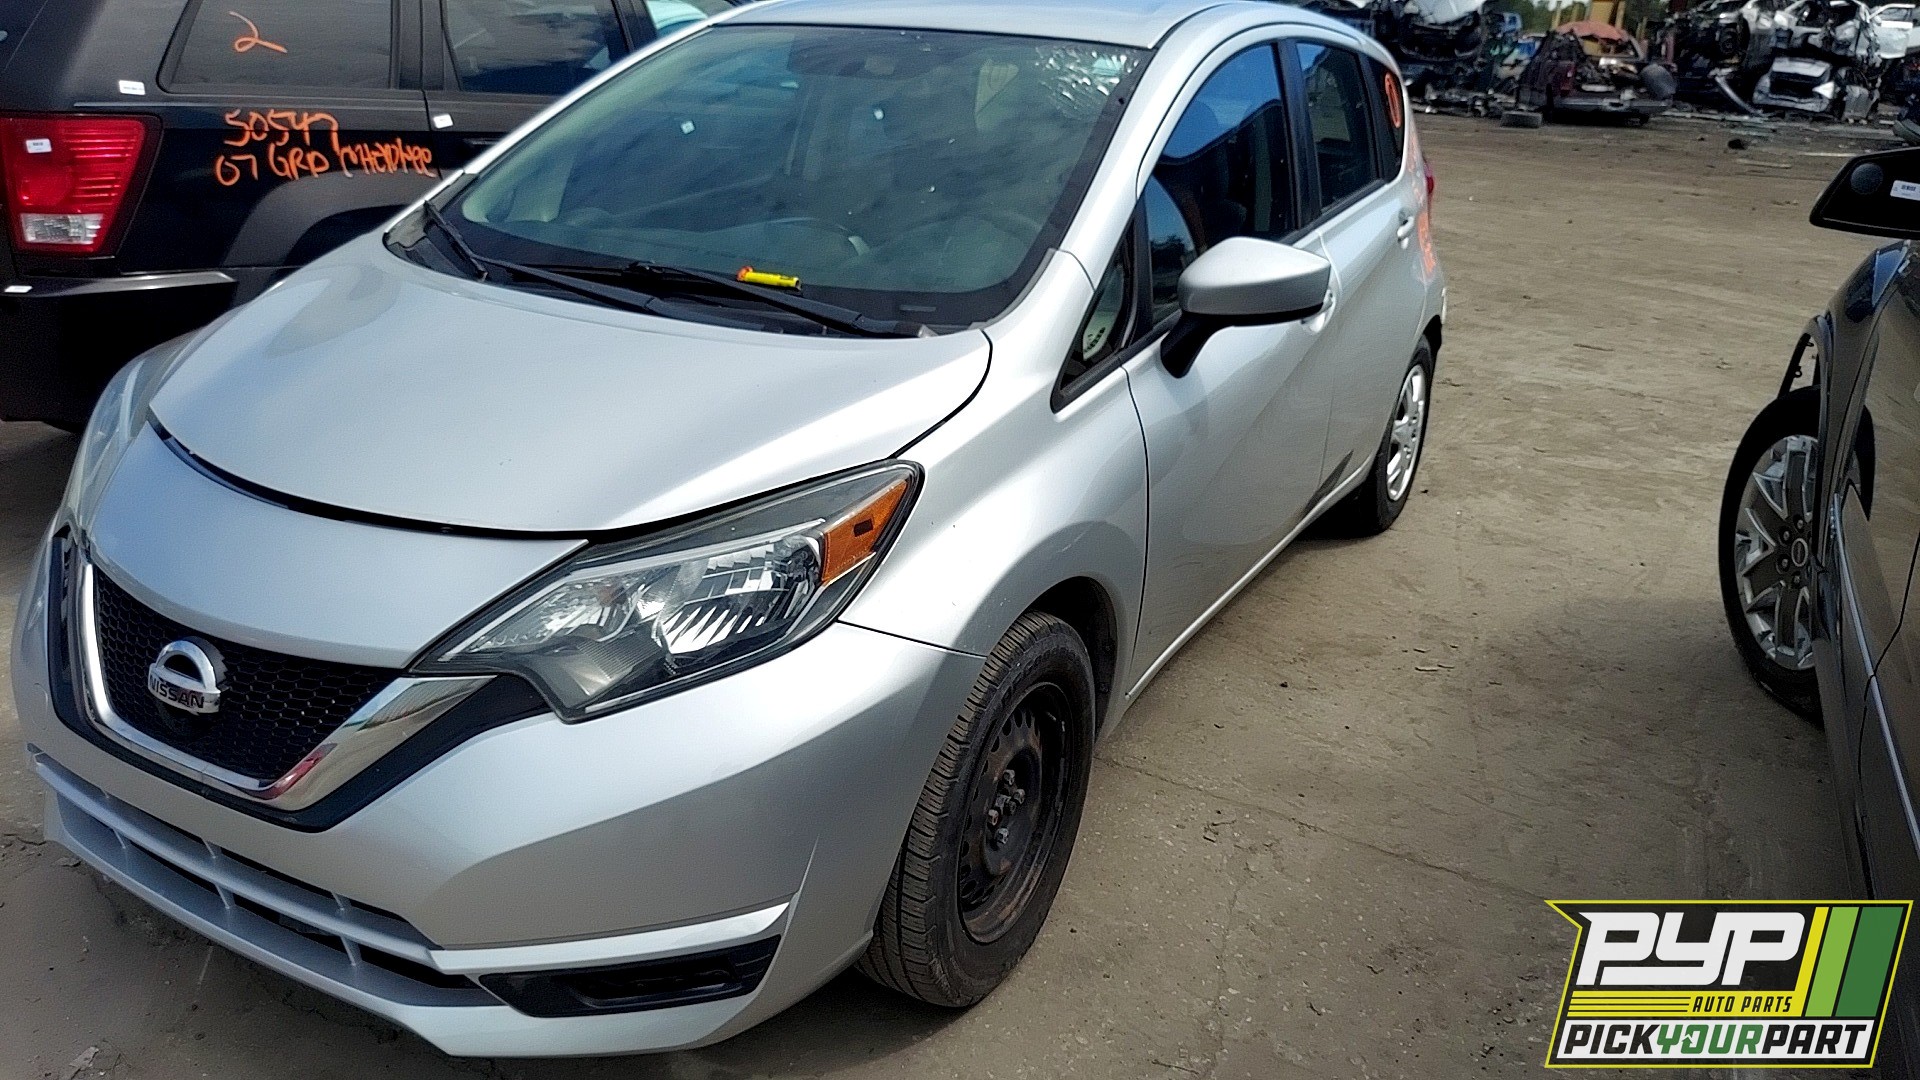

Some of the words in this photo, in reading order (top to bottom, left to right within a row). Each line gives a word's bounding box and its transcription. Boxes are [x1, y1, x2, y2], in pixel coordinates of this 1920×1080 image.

[229, 11, 288, 53] 2
[215, 154, 259, 186] 07
[150, 674, 205, 709] NISSAN
